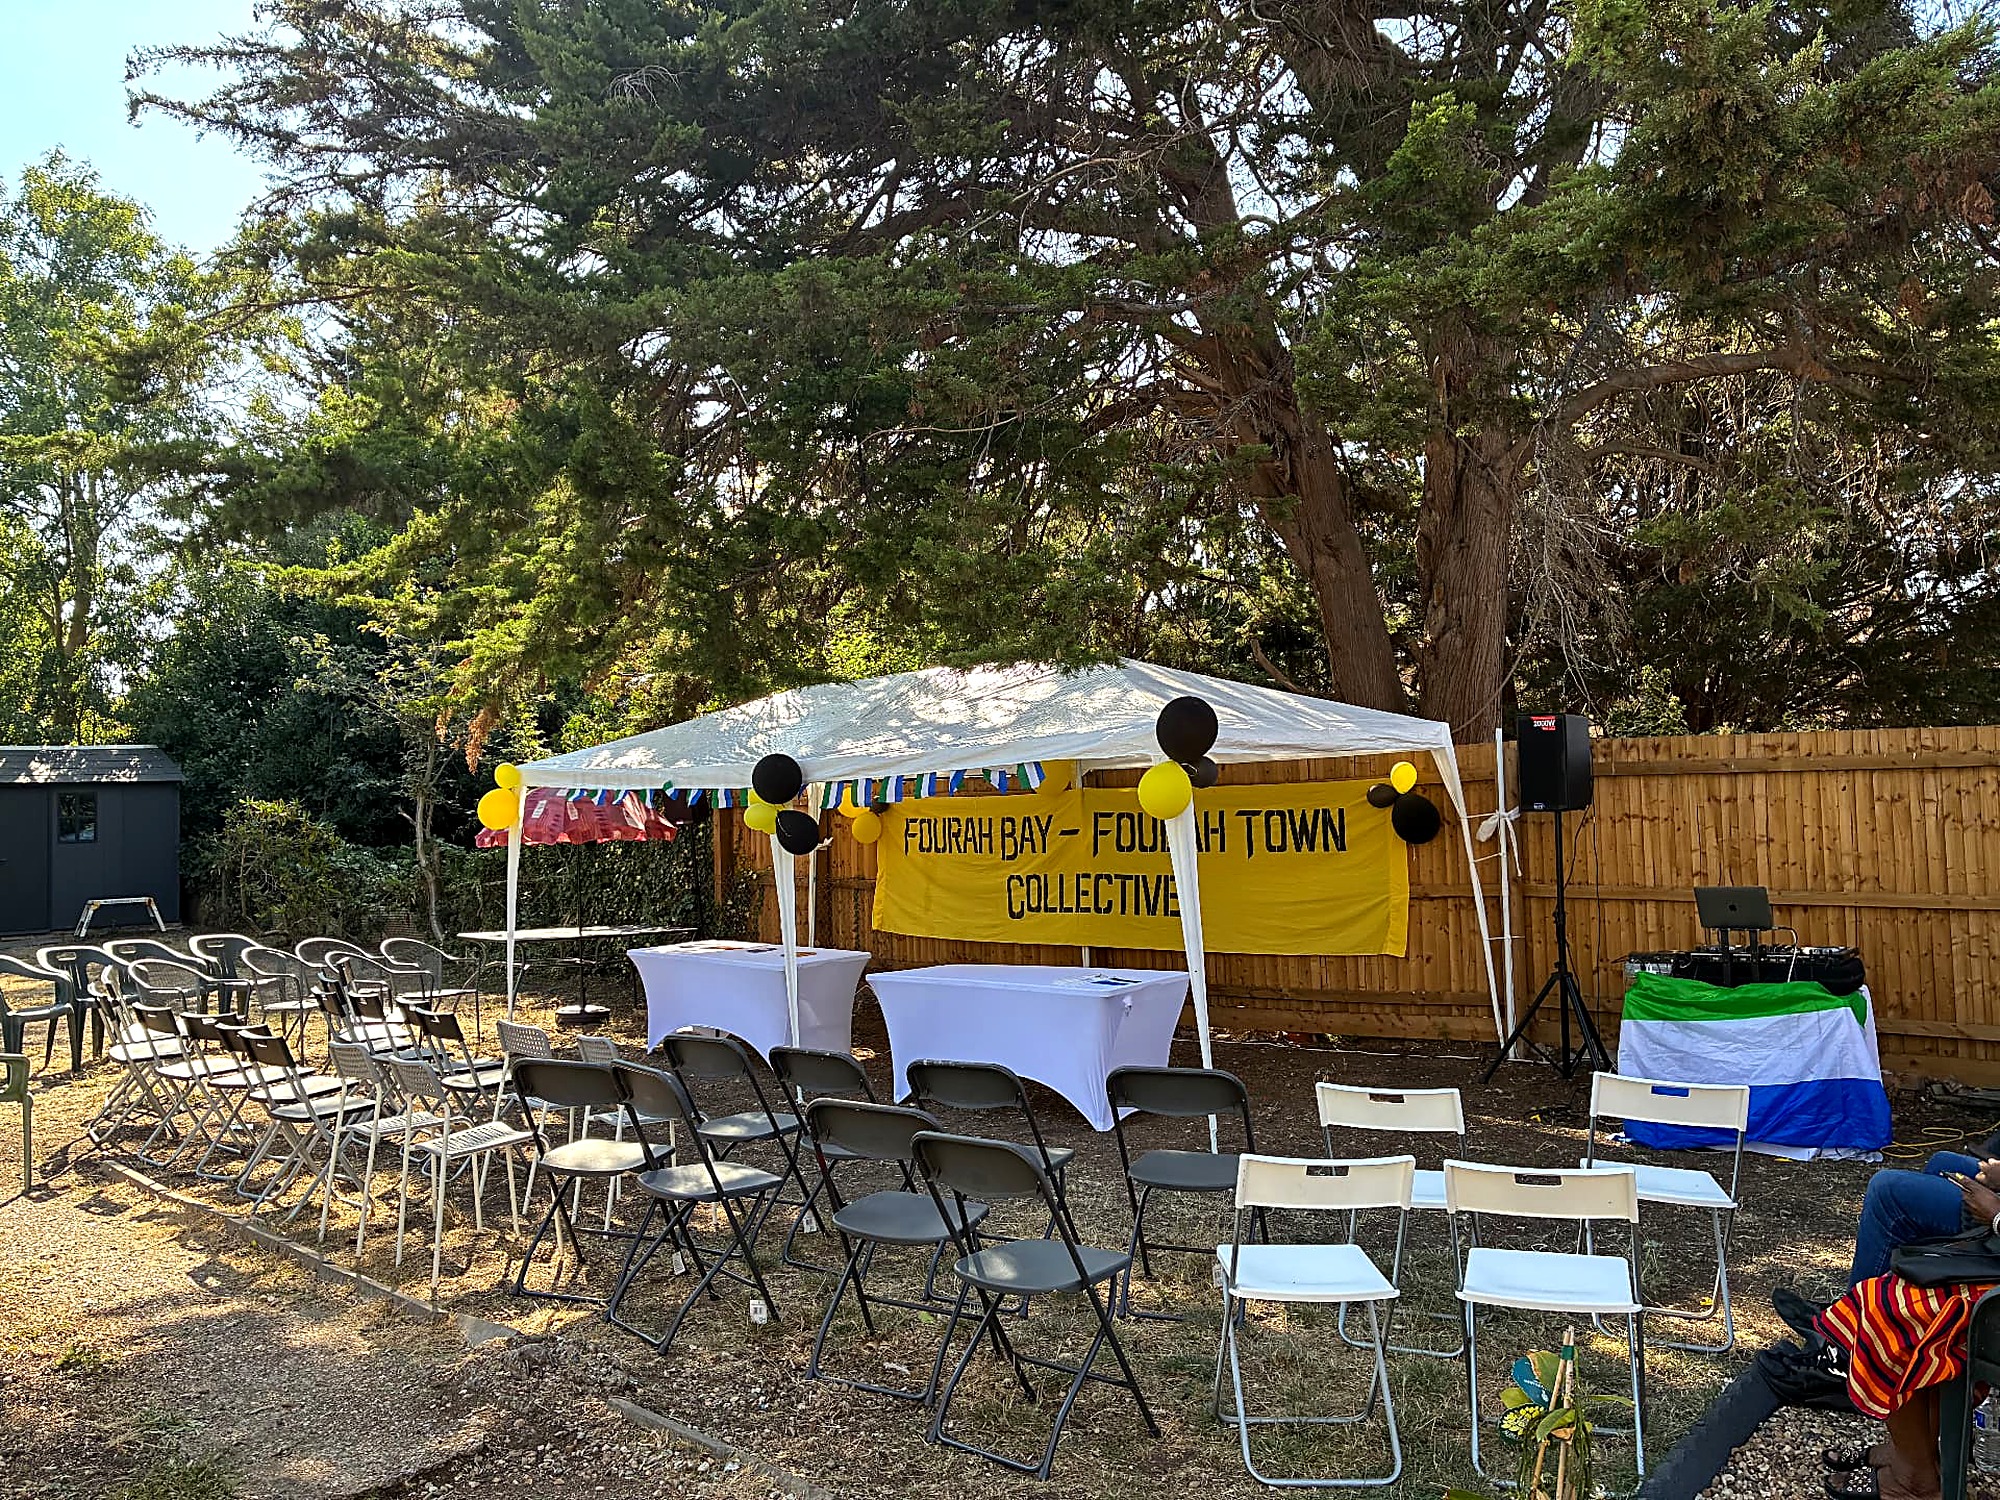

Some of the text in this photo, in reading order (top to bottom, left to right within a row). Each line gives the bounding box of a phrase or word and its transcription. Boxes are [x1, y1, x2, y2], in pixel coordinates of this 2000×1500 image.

[904, 816, 993, 856] FOURAH
[1000, 814, 1054, 861] BAY
[1235, 807, 1347, 861] TOWN
[1006, 872, 1182, 920] COLLECTIVE
